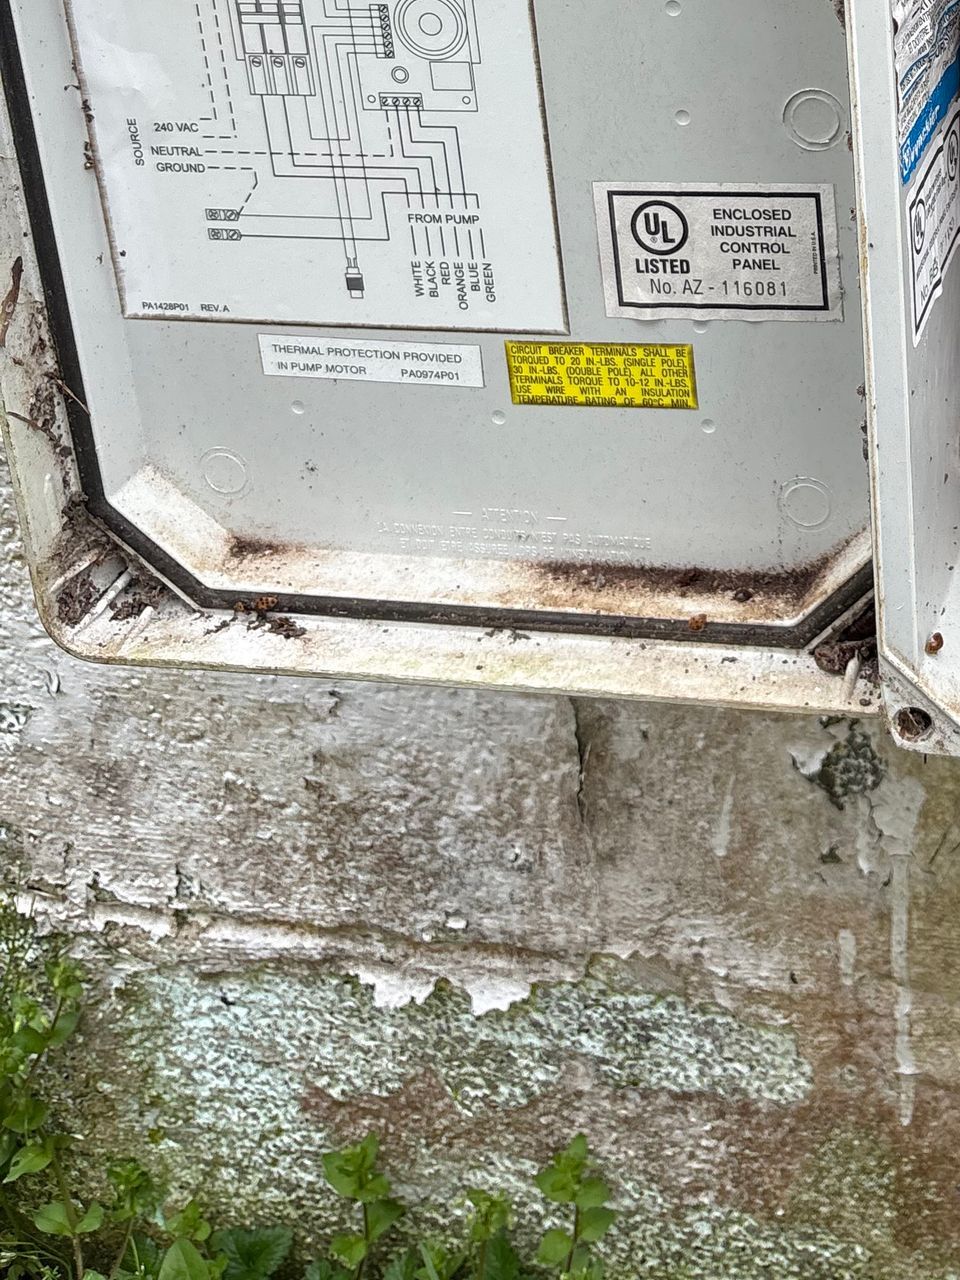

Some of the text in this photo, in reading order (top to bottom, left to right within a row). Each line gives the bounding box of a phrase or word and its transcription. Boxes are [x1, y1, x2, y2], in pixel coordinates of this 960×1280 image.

[154, 122, 199, 133] 240 VAC
[126, 118, 145, 167] SOURCE
[151, 146, 203, 157] NEUTRAL
[156, 163, 205, 173] GROUND
[408, 214, 479, 224] FROM PUMP
[713, 209, 792, 221] ENCLOSED
[644, 212, 675, 243] UL
[711, 225, 797, 238] INDUSTRIAL
[720, 242, 791, 254] CONTROL
[635, 258, 690, 274] LISTED
[732, 258, 781, 270] PANEL
[411, 261, 425, 297] WHITE
[425, 261, 439, 298] BLACK
[440, 261, 451, 285] RED
[468, 262, 480, 291] BLUE
[454, 262, 468, 310] ORANGE
[482, 263, 496, 302] GREEN
[650, 279, 677, 295] No.
[682, 279, 703, 295] AZ
[722, 280, 787, 297] 116081
[142, 301, 189, 311] PA1428P01
[272, 344, 462, 363] THERMAL PROTECTION PROVIDED
[511, 345, 686, 358] CIRCUIT BREAKER TERMINALS SHALL BE
[277, 361, 367, 375] IN PUMP MOTOR
[512, 356, 549, 365] TORQUED
[555, 357, 566, 365] TO
[570, 357, 580, 366] 20
[624, 358, 655, 368] (SINGLE
[401, 369, 459, 380] PA0974P01
[513, 365, 523, 374] 30
[566, 366, 601, 377] (DOUBLE
[640, 368, 655, 377] ALL
[662, 369, 688, 378] OTHER
[515, 375, 563, 385] TERMINALS
[568, 376, 603, 386] TORQUE
[609, 377, 620, 386] TO
[626, 378, 649, 387] 10-12
[516, 385, 690, 397] USE WIRE WITH AN INSULATION
[518, 395, 578, 405] TEMPERATURE
[586, 396, 616, 406] RATING
[624, 397, 636, 406] OF
